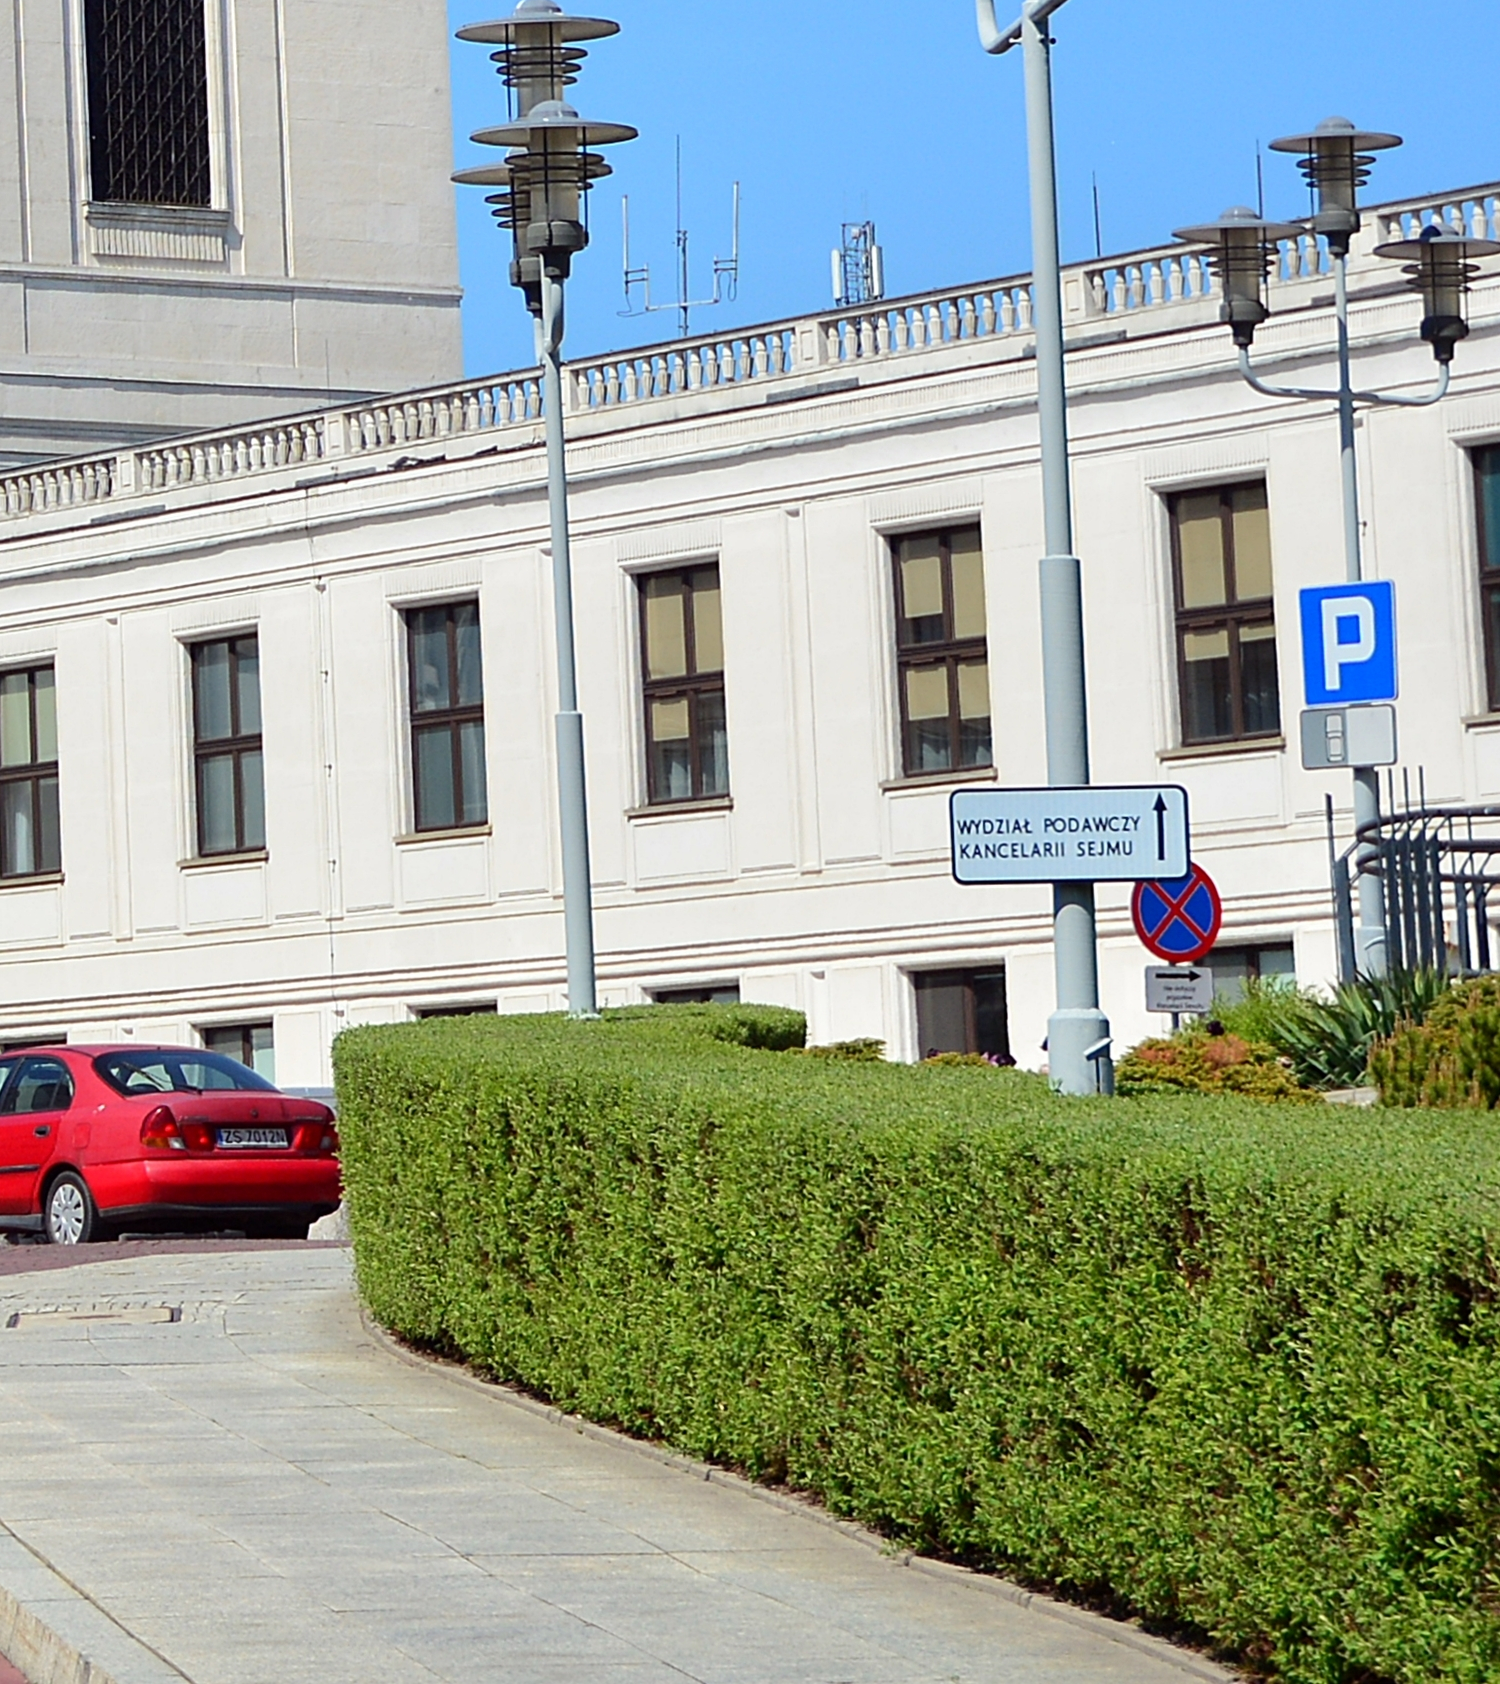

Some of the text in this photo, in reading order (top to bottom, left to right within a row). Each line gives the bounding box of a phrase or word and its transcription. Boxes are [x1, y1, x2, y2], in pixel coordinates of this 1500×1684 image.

[1321, 596, 1375, 691] P
[957, 816, 1141, 835] WYDZIAŁ PODAWCZY
[960, 841, 1133, 859] KANCELARII SEJMU
[223, 1129, 286, 1144] ZS 7012N
